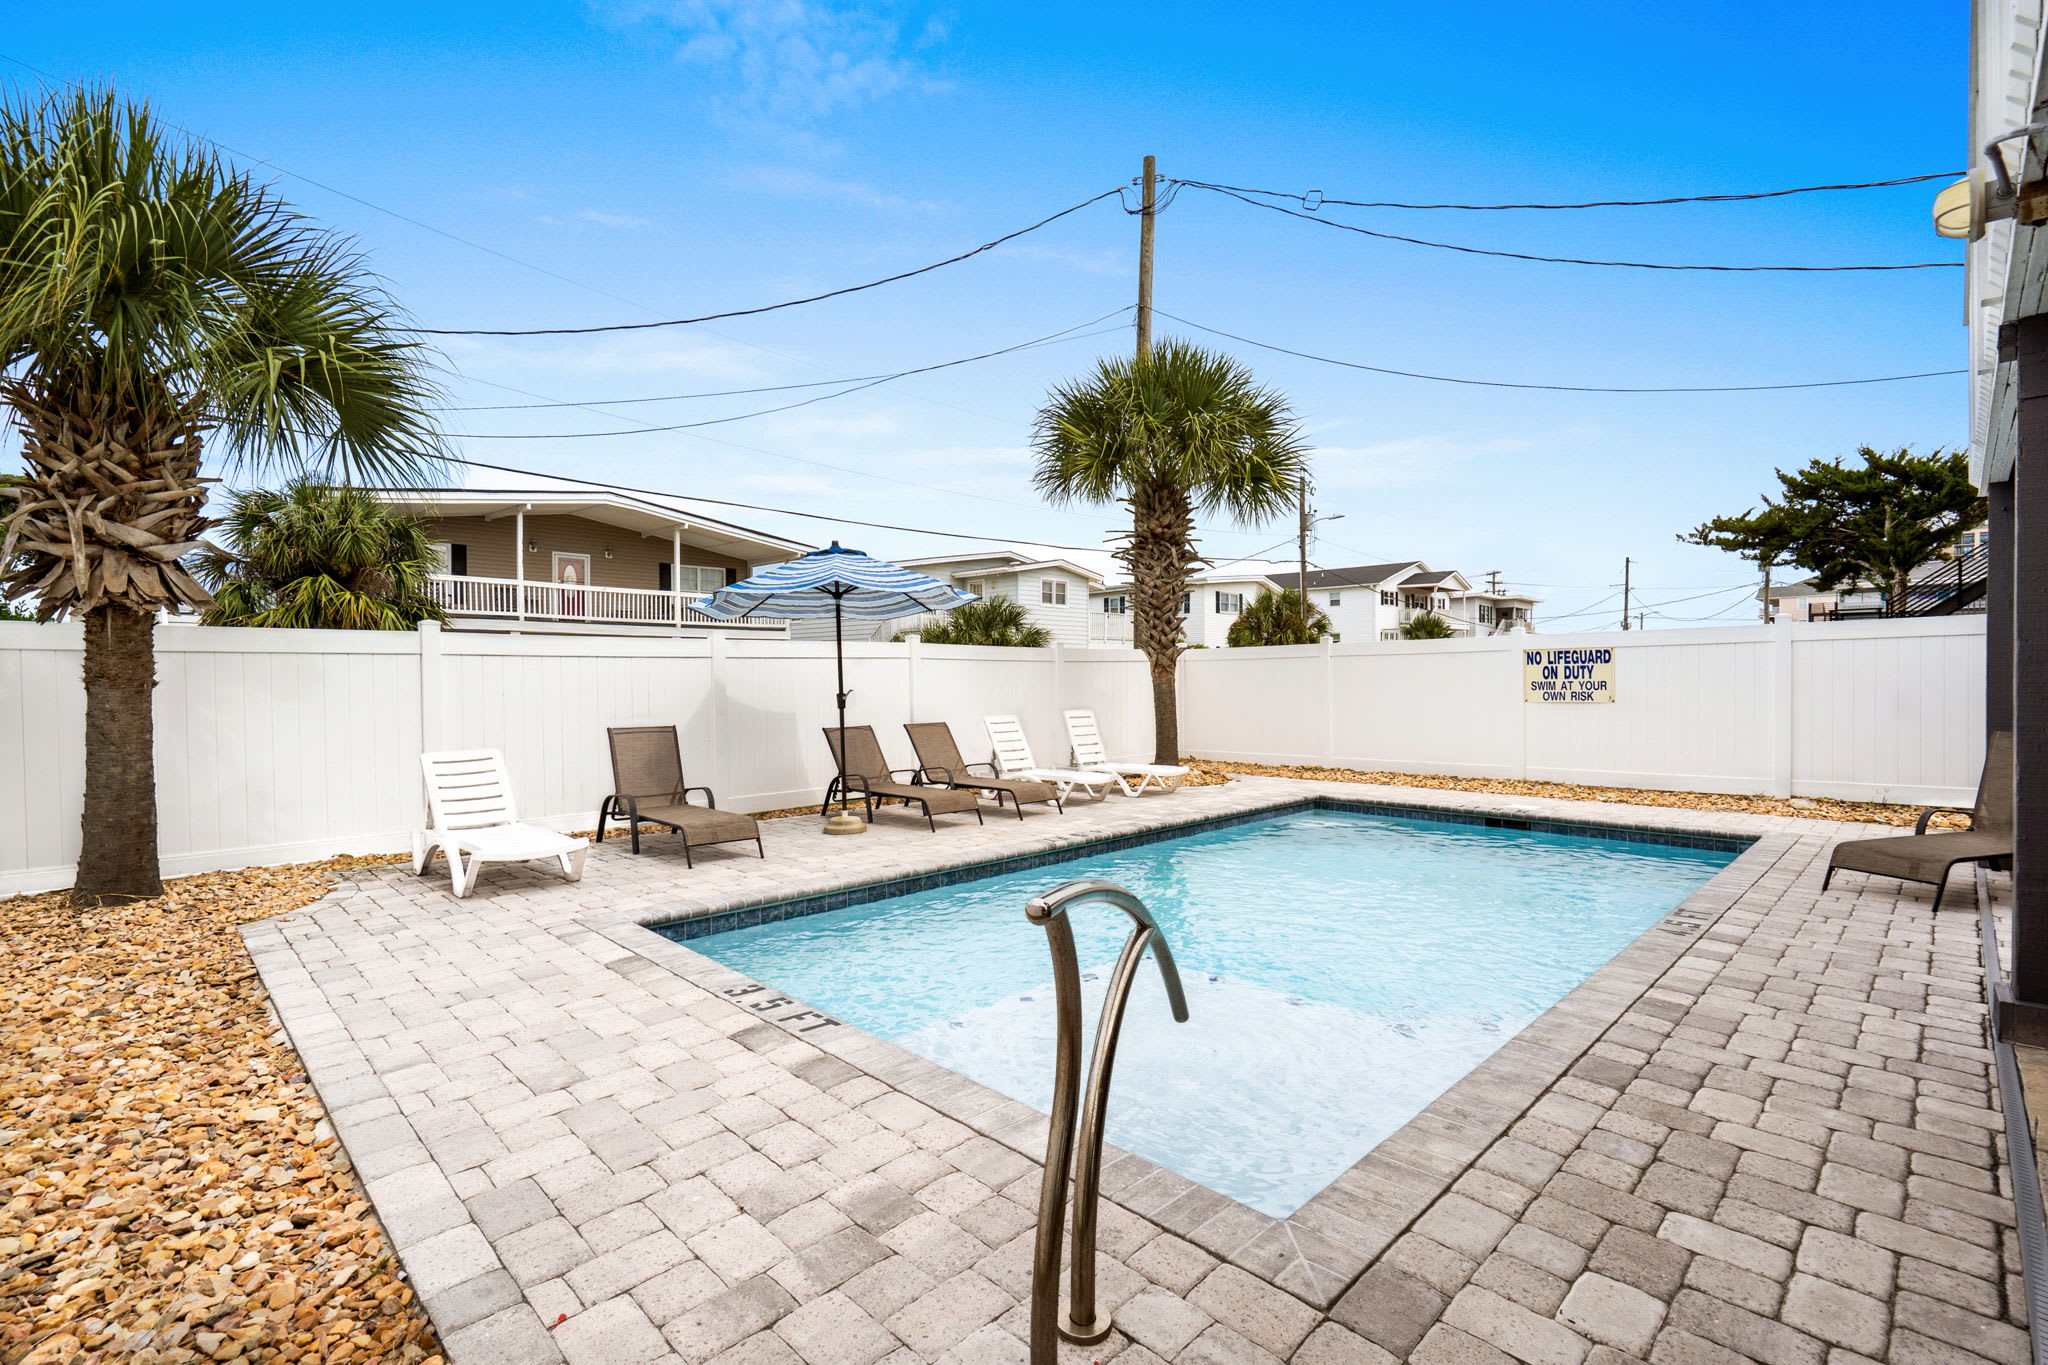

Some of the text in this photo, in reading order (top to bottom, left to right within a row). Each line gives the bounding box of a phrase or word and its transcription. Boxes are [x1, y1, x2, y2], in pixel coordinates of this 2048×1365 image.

[1526, 649, 1611, 665] NO LIFEGUARD
[1542, 665, 1594, 679] ON DUTY
[1531, 681, 1607, 690] SWIM AT YOUR
[1542, 691, 1594, 701] OWN RISK
[1673, 908, 1713, 920] FT
[723, 984, 842, 1033] 3.5 FT
